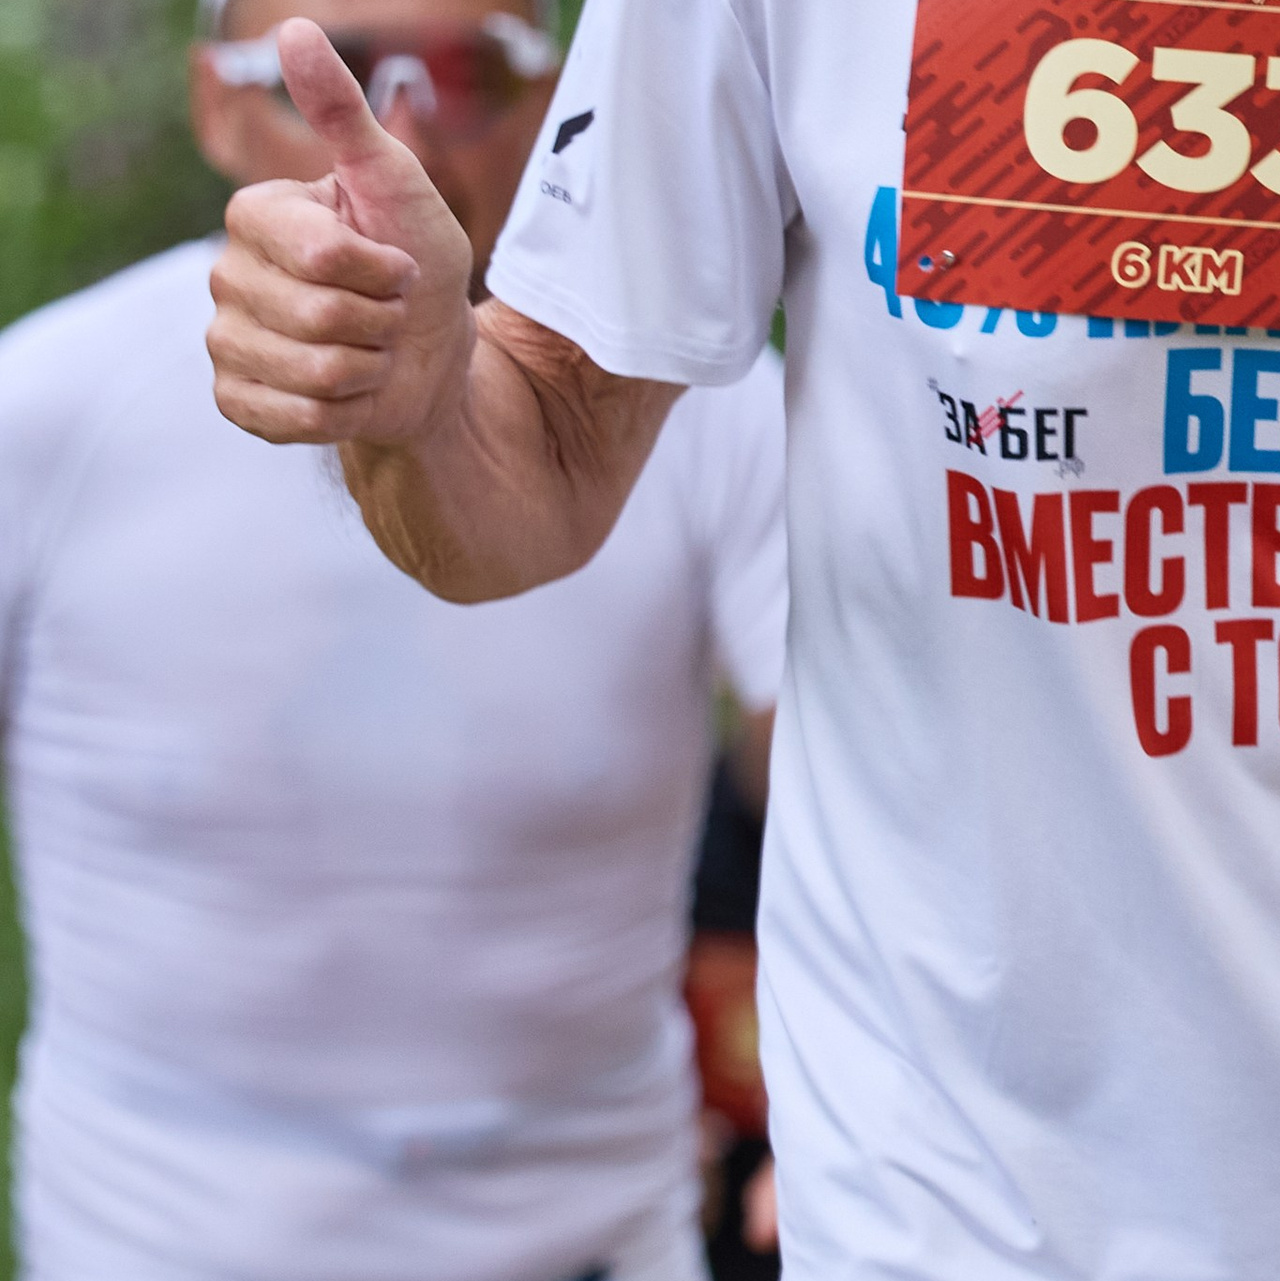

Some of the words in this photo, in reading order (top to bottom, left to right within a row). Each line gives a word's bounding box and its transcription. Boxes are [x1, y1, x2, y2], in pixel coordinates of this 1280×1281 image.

[1111, 241, 1152, 289] 6
[1157, 244, 1244, 296] КМ
[1128, 623, 1194, 758] С
